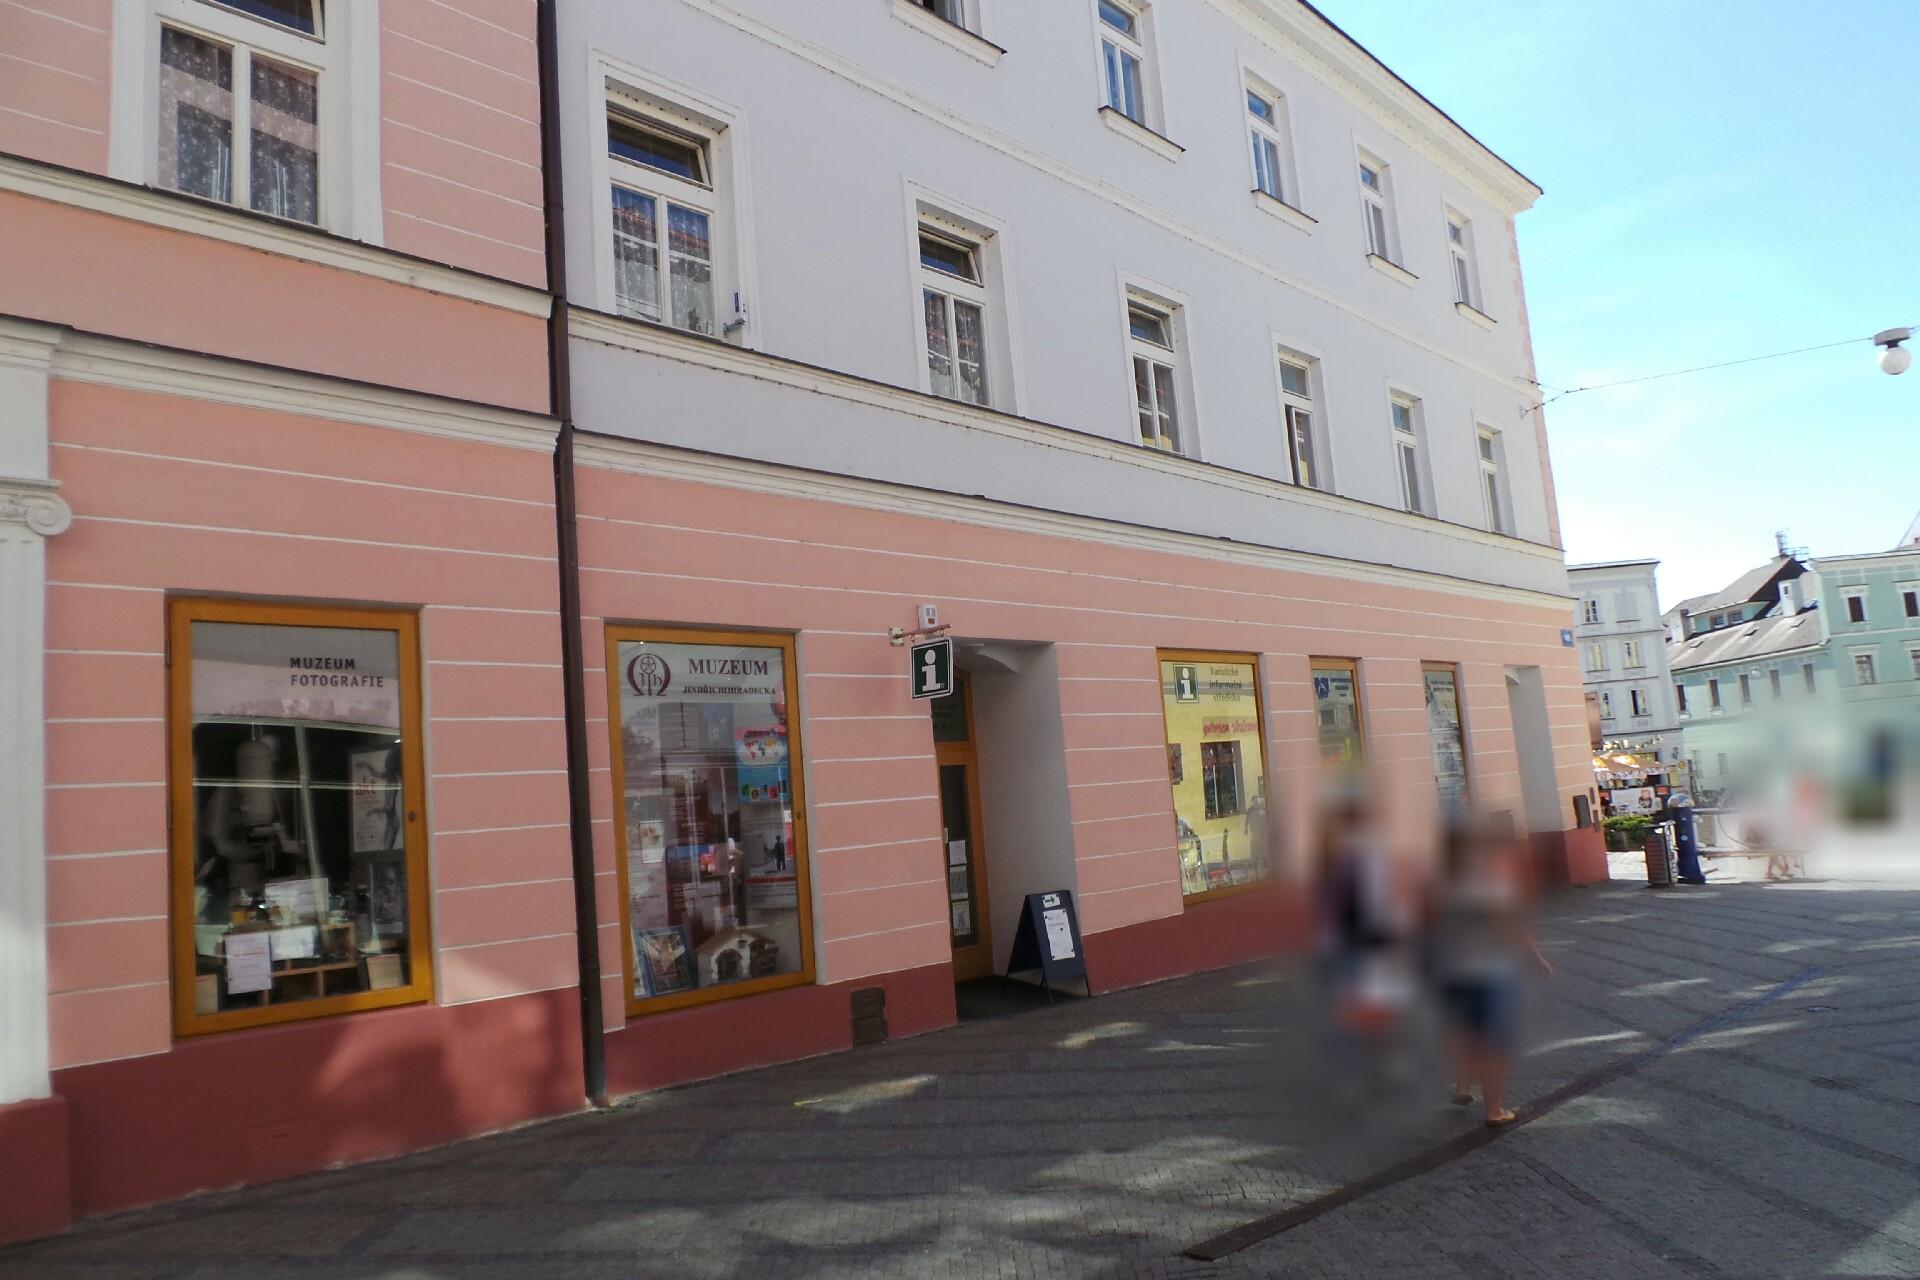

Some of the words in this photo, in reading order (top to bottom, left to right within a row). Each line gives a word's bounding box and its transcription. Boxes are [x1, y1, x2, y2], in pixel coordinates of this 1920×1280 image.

[289, 657, 356, 670] MUZEUM
[688, 658, 769, 675] MUZEUM
[290, 674, 384, 687] FOTOGRAFIE
